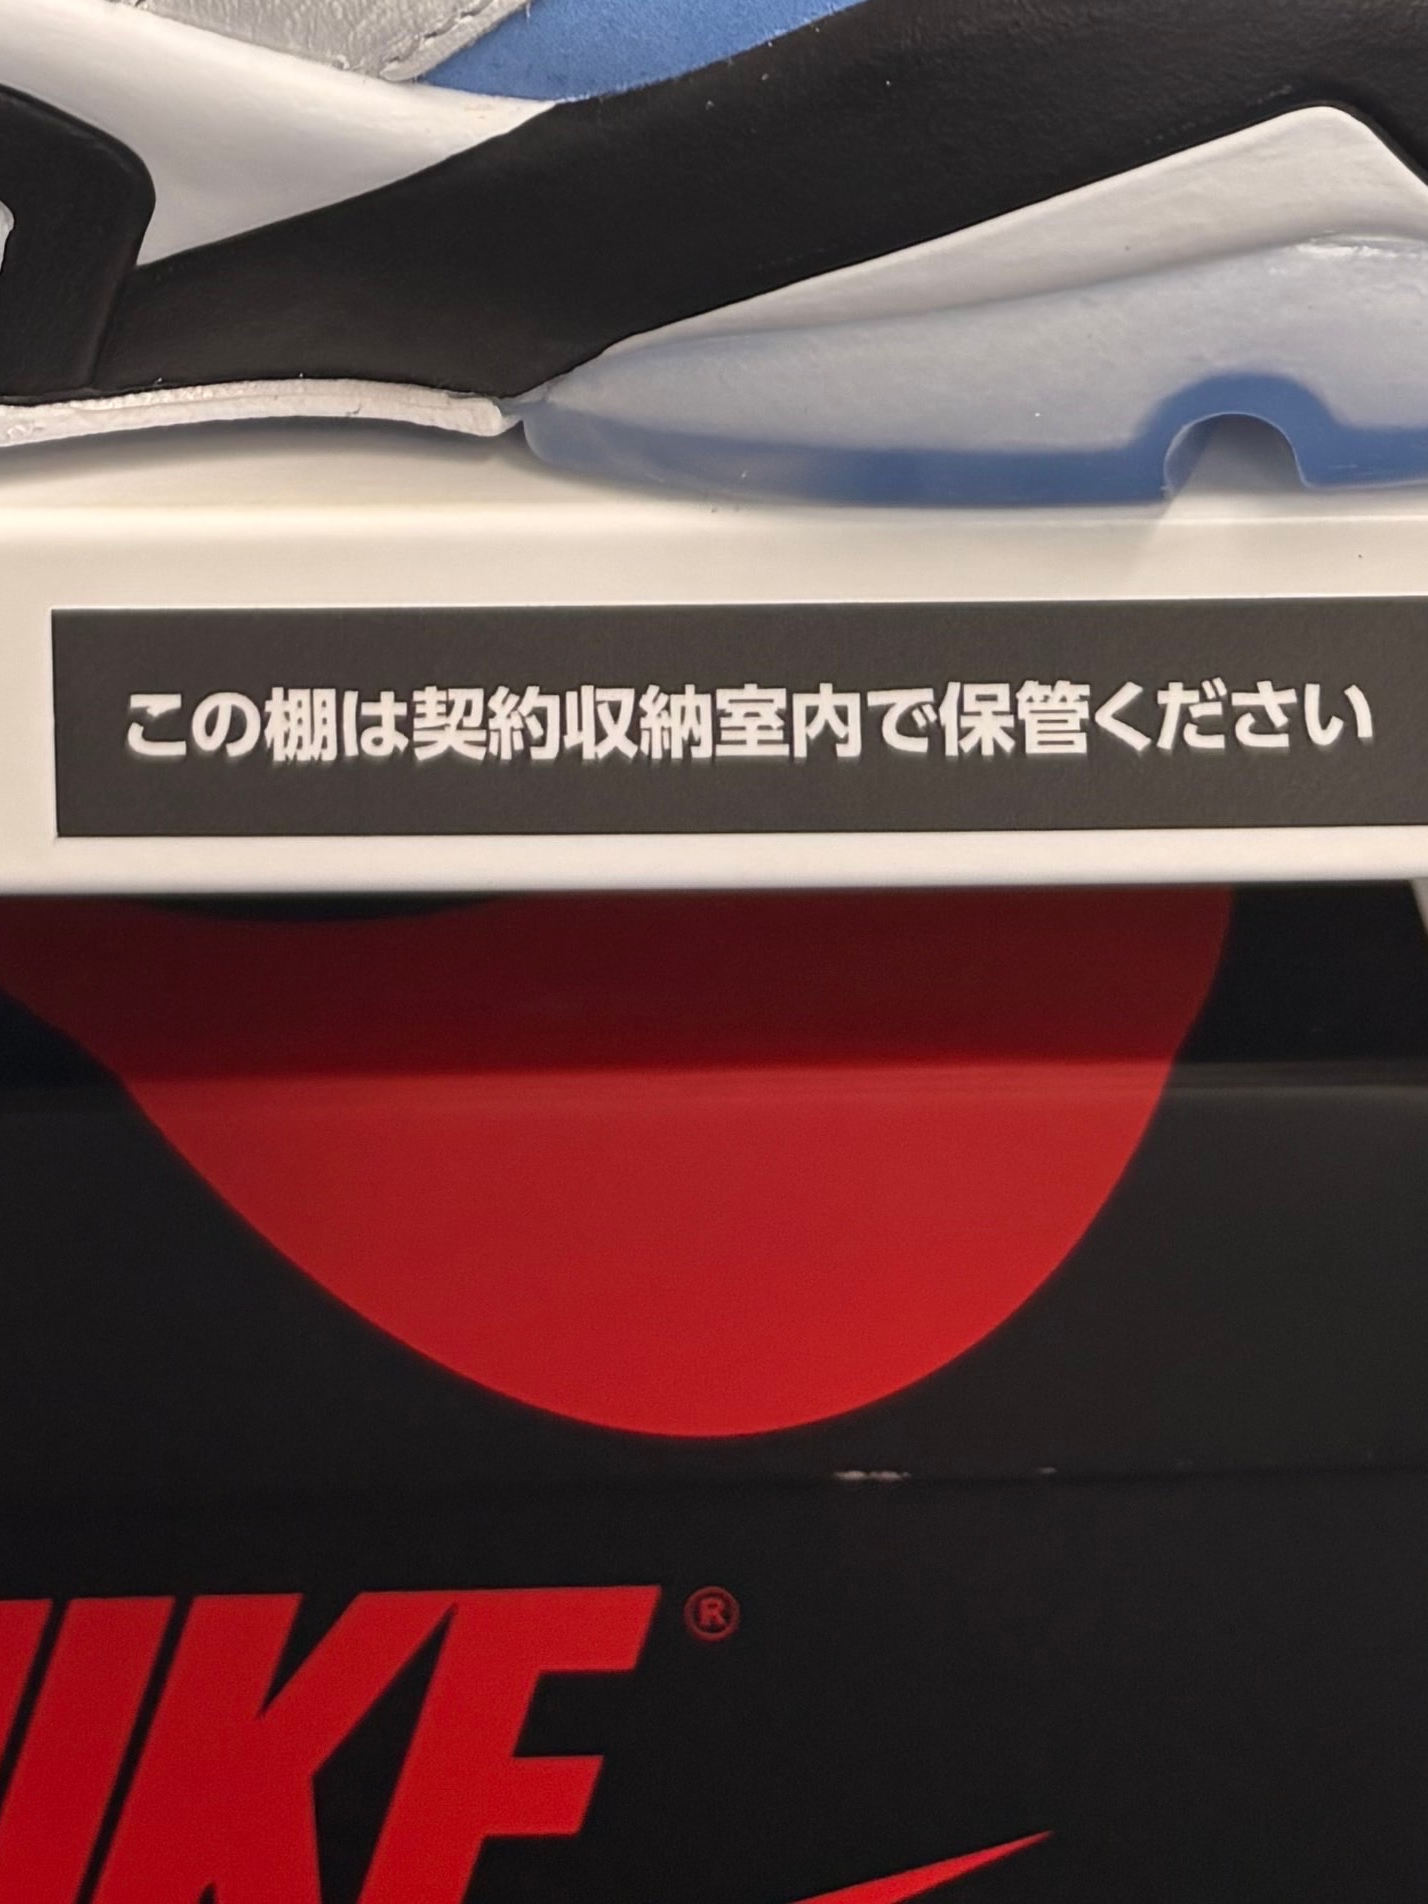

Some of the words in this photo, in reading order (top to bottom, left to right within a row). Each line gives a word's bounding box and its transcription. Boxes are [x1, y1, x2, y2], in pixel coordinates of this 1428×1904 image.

[127, 676, 1374, 763] この棚は契約収納室内で保管ください
